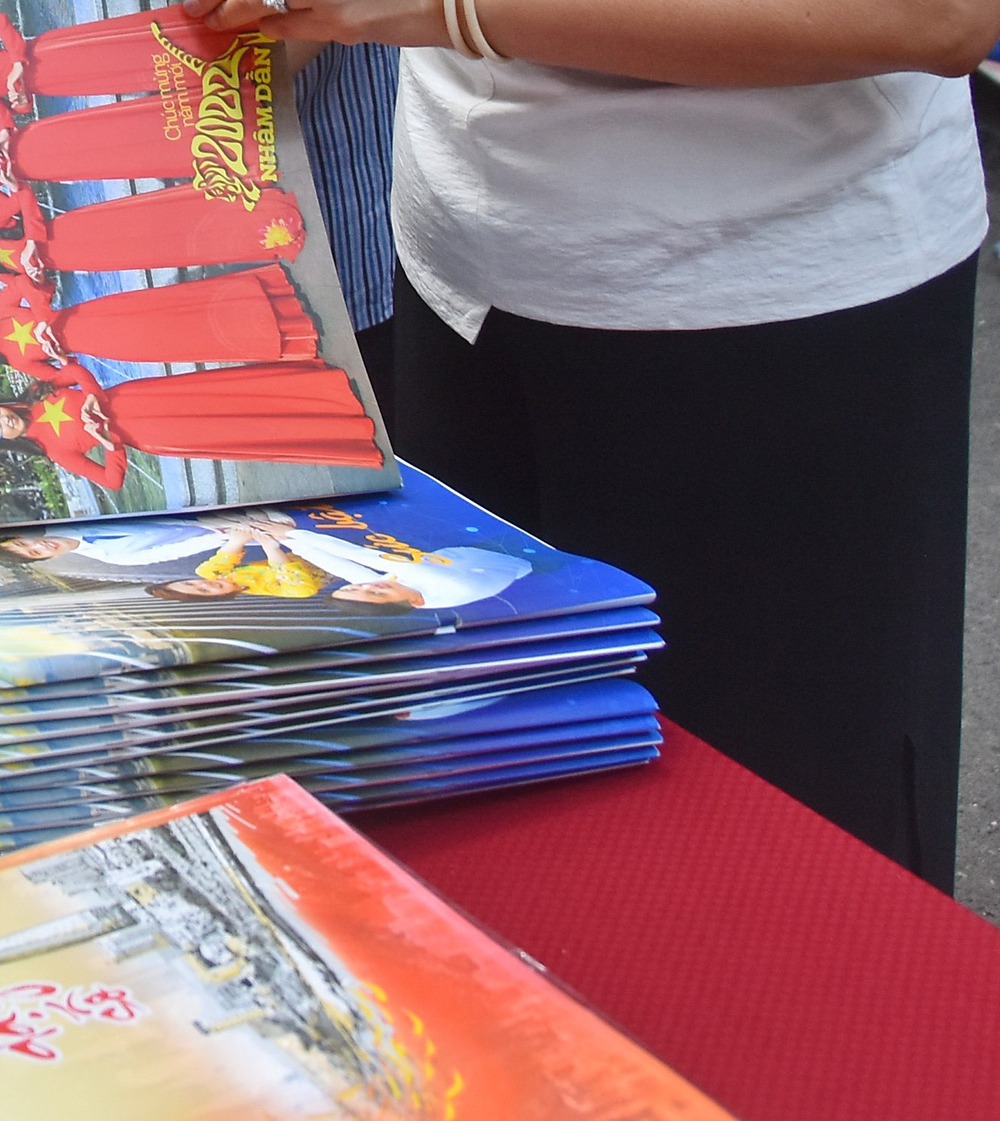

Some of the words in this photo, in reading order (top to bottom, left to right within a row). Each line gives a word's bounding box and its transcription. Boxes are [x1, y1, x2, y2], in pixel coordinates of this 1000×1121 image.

[152, 53, 173, 100] mừng
[167, 61, 188, 92] mới
[163, 100, 181, 141] Chúc
[177, 92, 194, 127] năm
